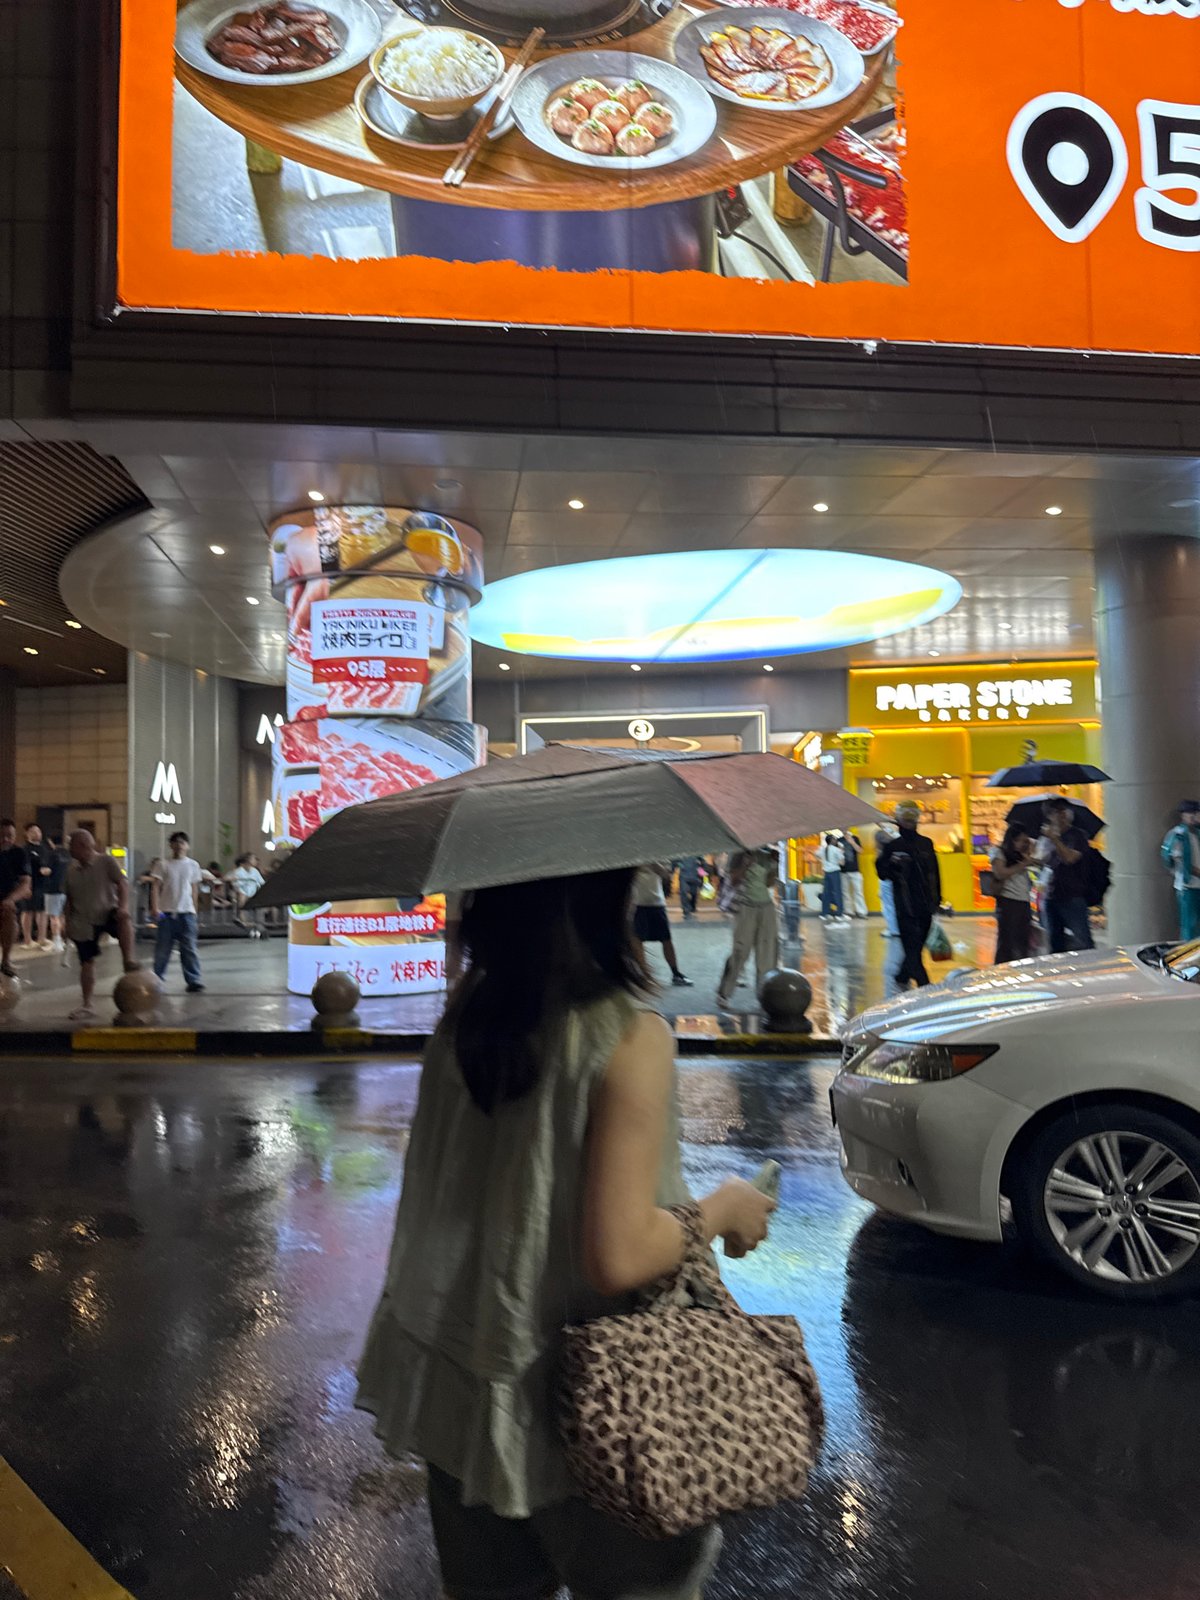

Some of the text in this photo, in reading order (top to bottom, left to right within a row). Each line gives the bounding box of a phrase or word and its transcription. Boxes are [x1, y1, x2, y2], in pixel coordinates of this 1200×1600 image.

[876, 679, 1072, 710] PAPER STONE
[919, 707, 1028, 721] BAKERY
